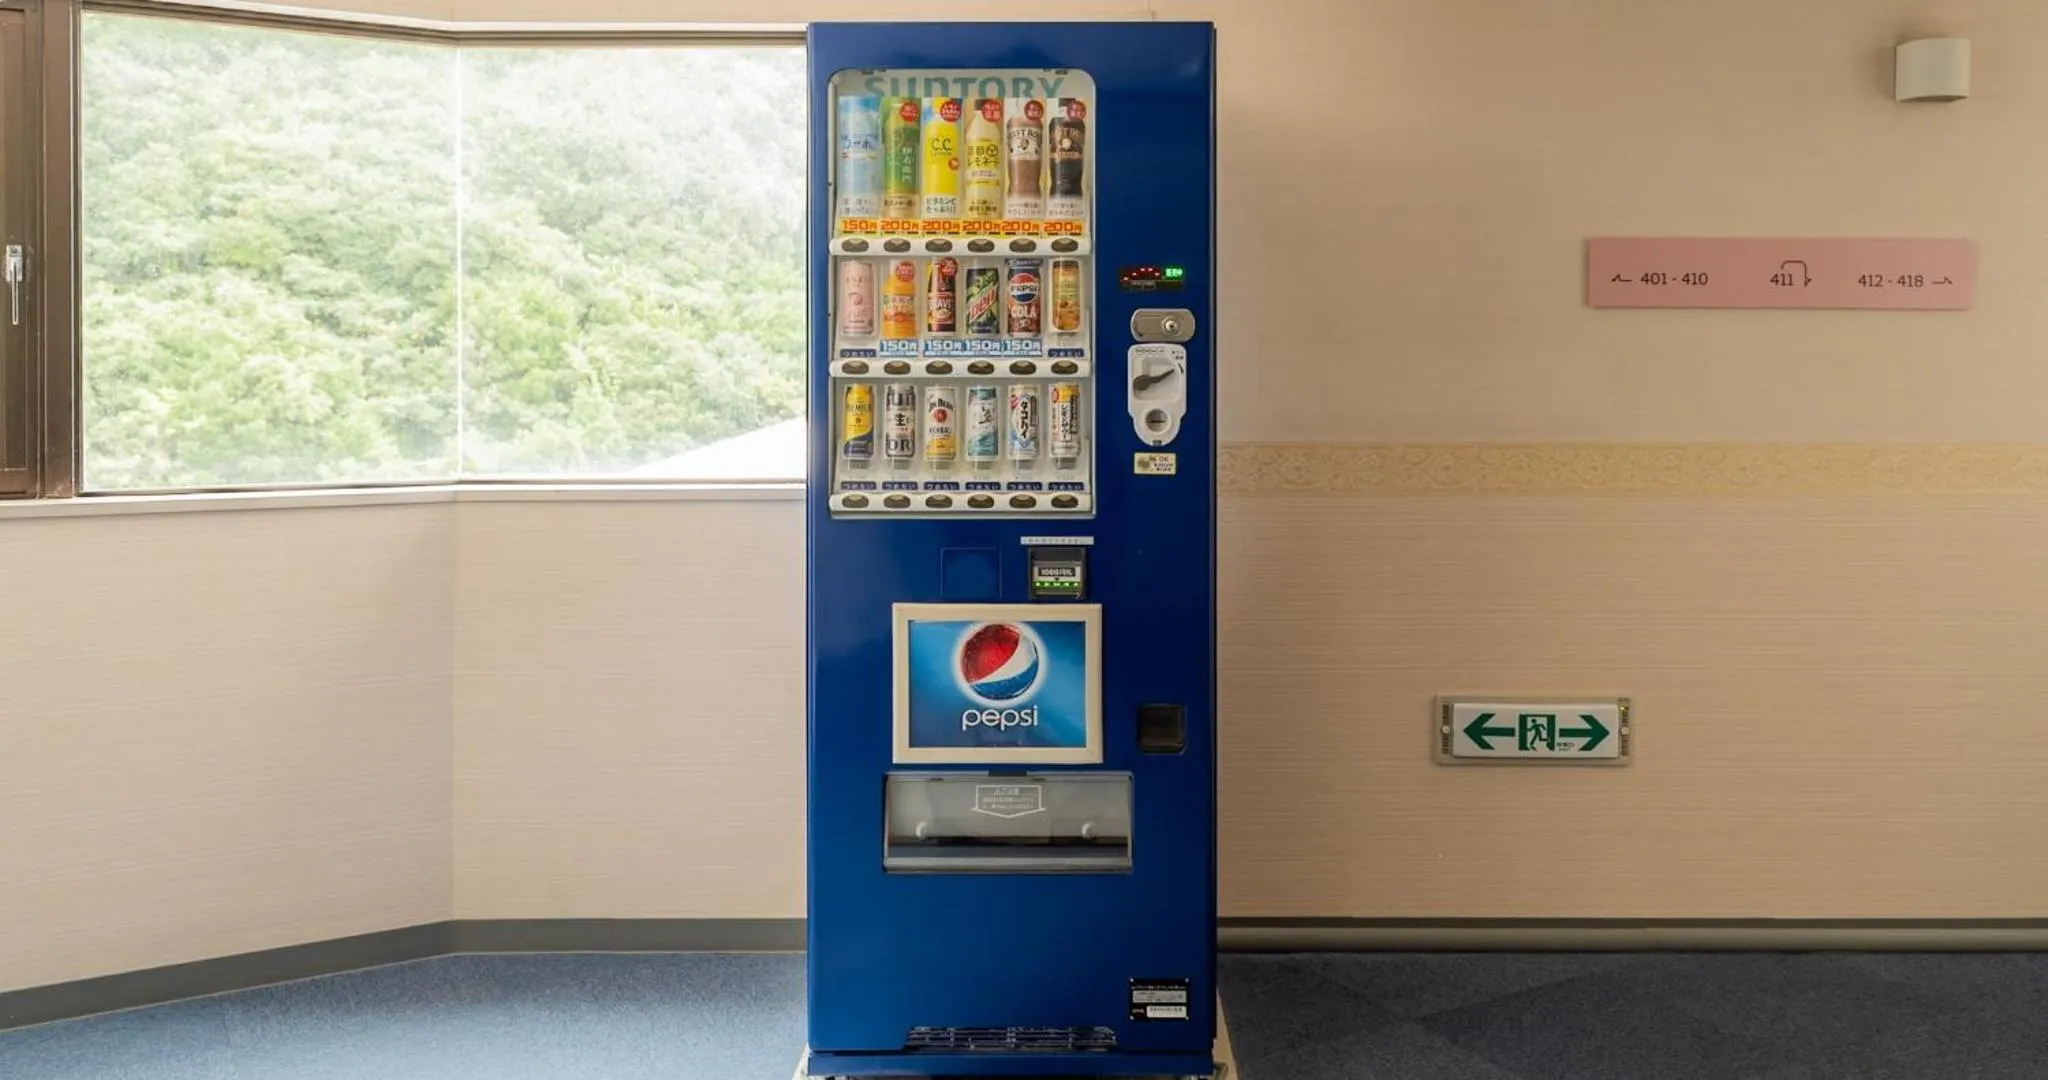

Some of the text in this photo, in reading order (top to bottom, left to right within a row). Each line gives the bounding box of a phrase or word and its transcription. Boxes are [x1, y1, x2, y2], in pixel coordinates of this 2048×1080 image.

[1640, 272, 1667, 286] 401
[1681, 272, 1709, 286] 410
[1770, 273, 1794, 286] 411
[1858, 274, 1884, 288] 412
[1897, 274, 1924, 288] 418
[1011, 305, 1037, 318] COLA
[962, 705, 1038, 731] pepsi
